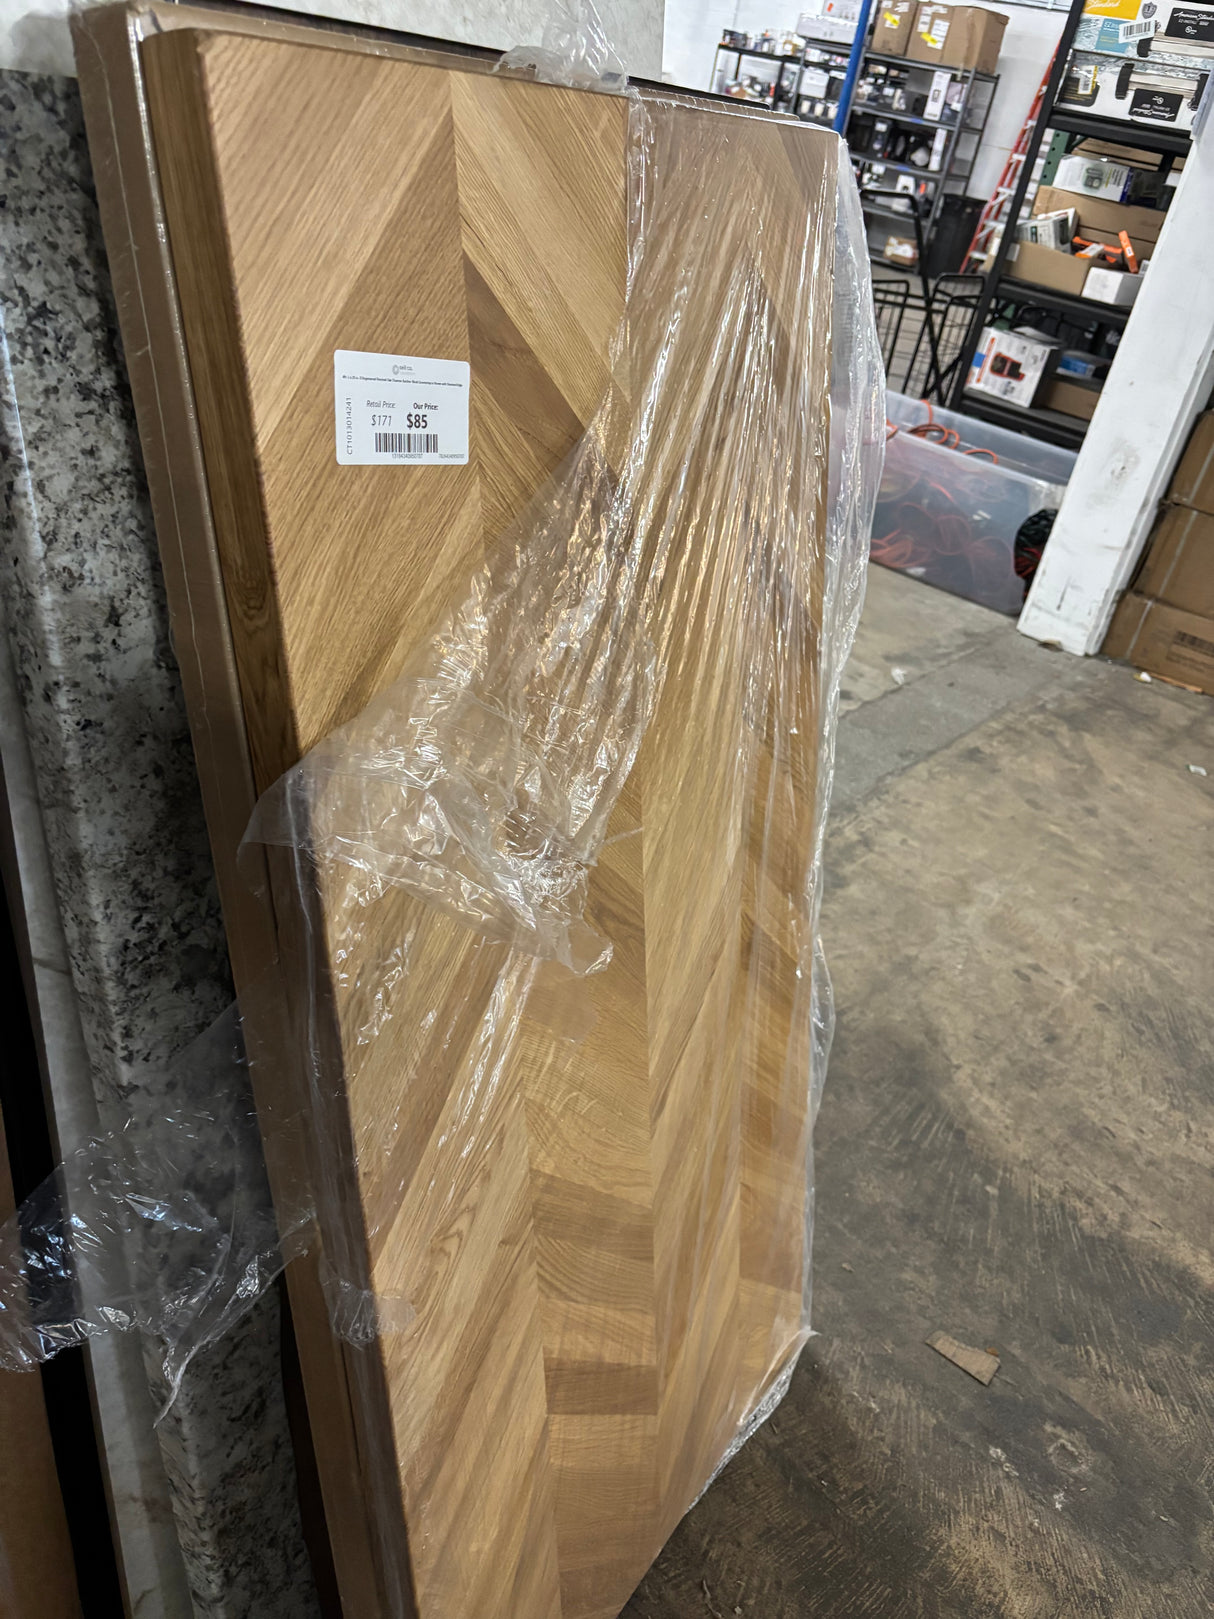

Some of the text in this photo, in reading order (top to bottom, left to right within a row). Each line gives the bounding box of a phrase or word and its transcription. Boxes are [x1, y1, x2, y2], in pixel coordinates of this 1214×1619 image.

[366, 400, 381, 408] Retail
[413, 402, 424, 410] Our
[406, 412, 428, 430] $85
